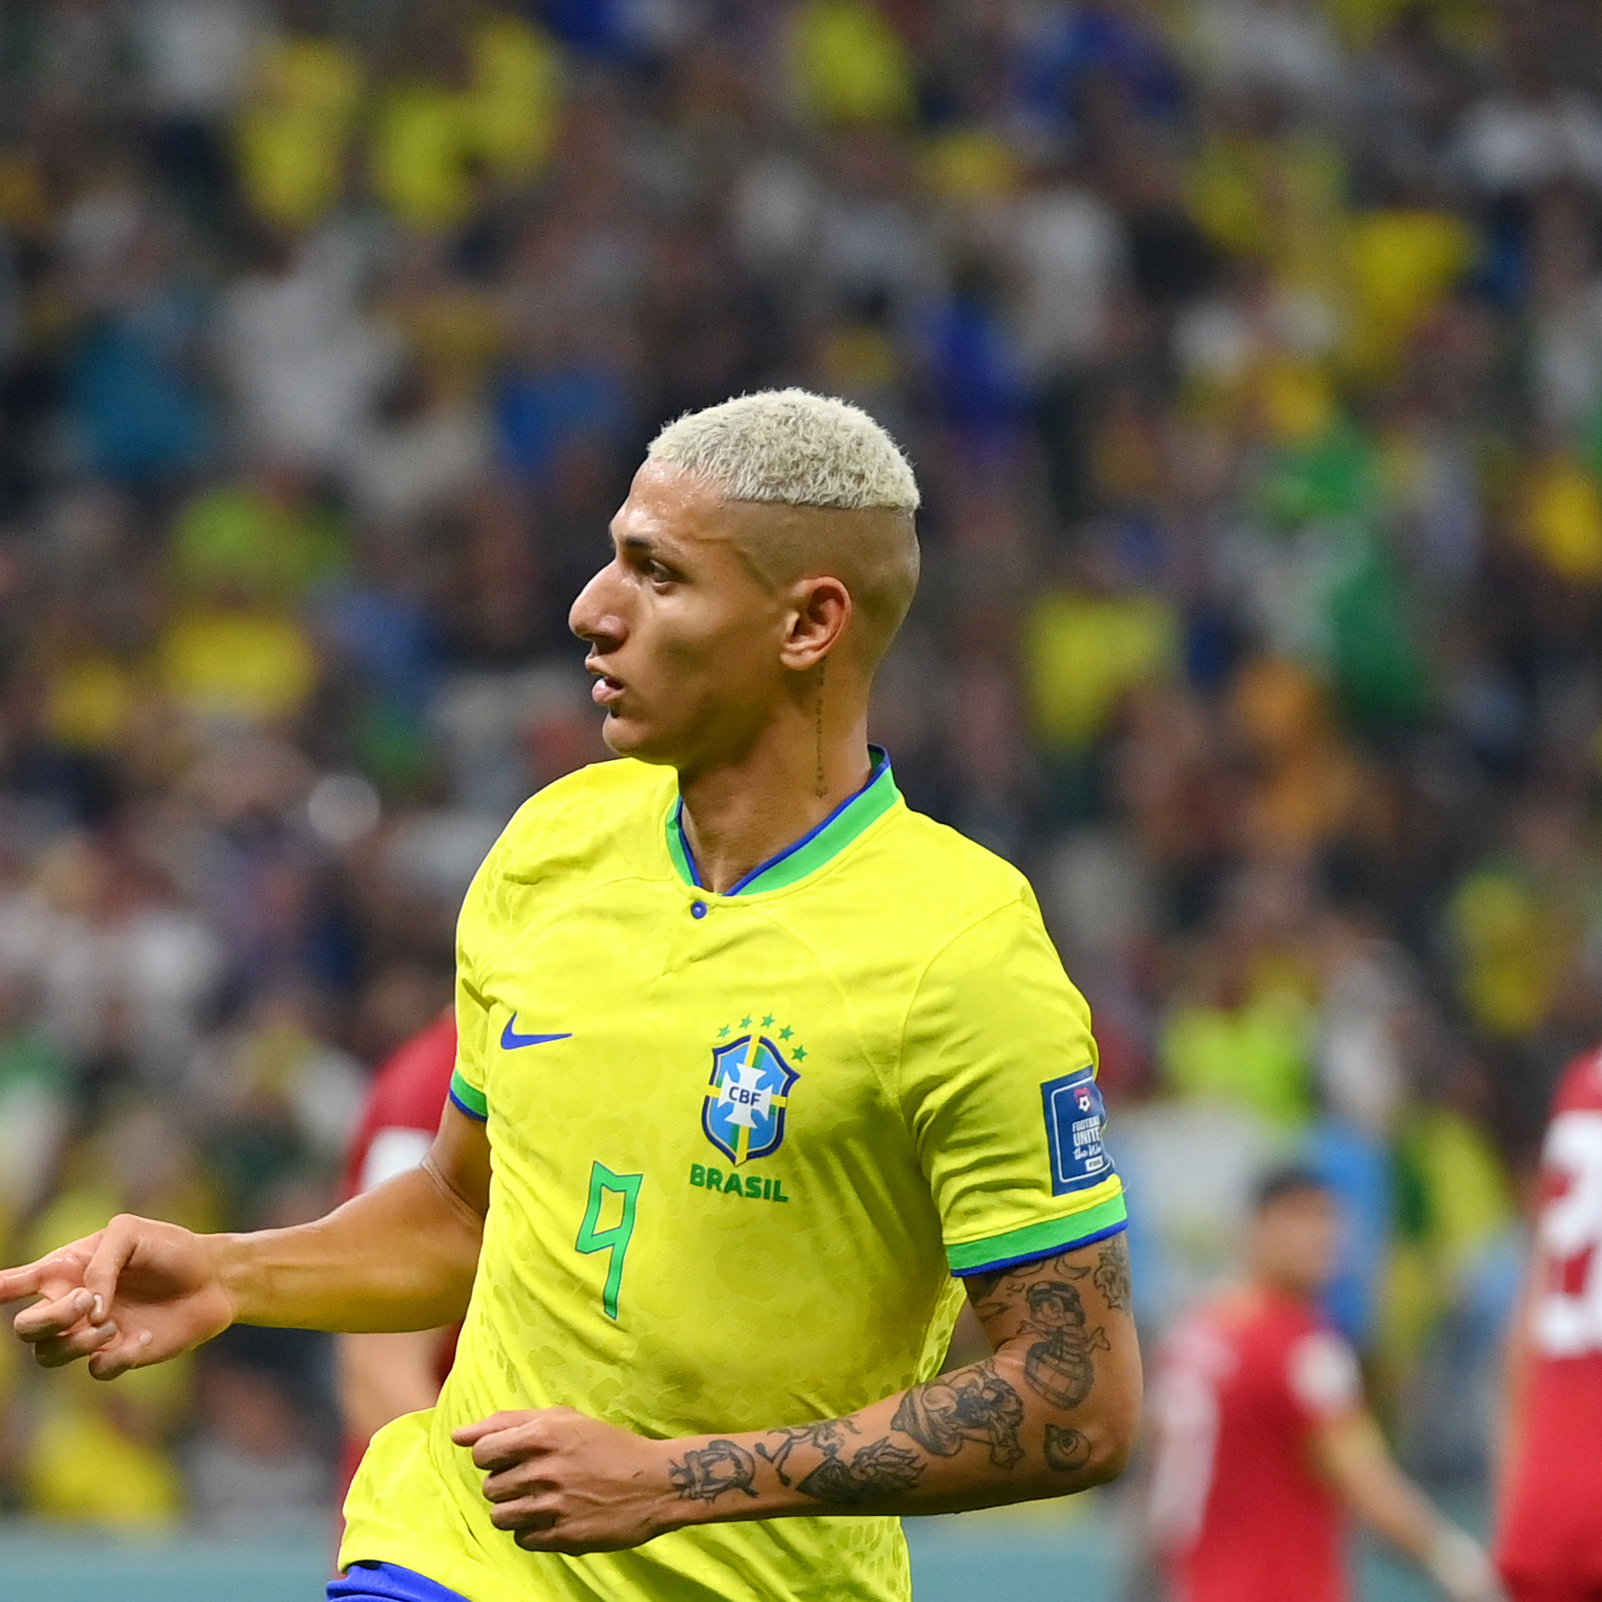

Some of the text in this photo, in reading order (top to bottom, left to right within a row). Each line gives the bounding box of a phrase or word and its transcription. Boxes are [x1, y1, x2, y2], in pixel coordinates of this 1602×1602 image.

[729, 1086, 761, 1107] CBF
[689, 1162, 790, 1203] BRASIL
[574, 1160, 644, 1321] 9
